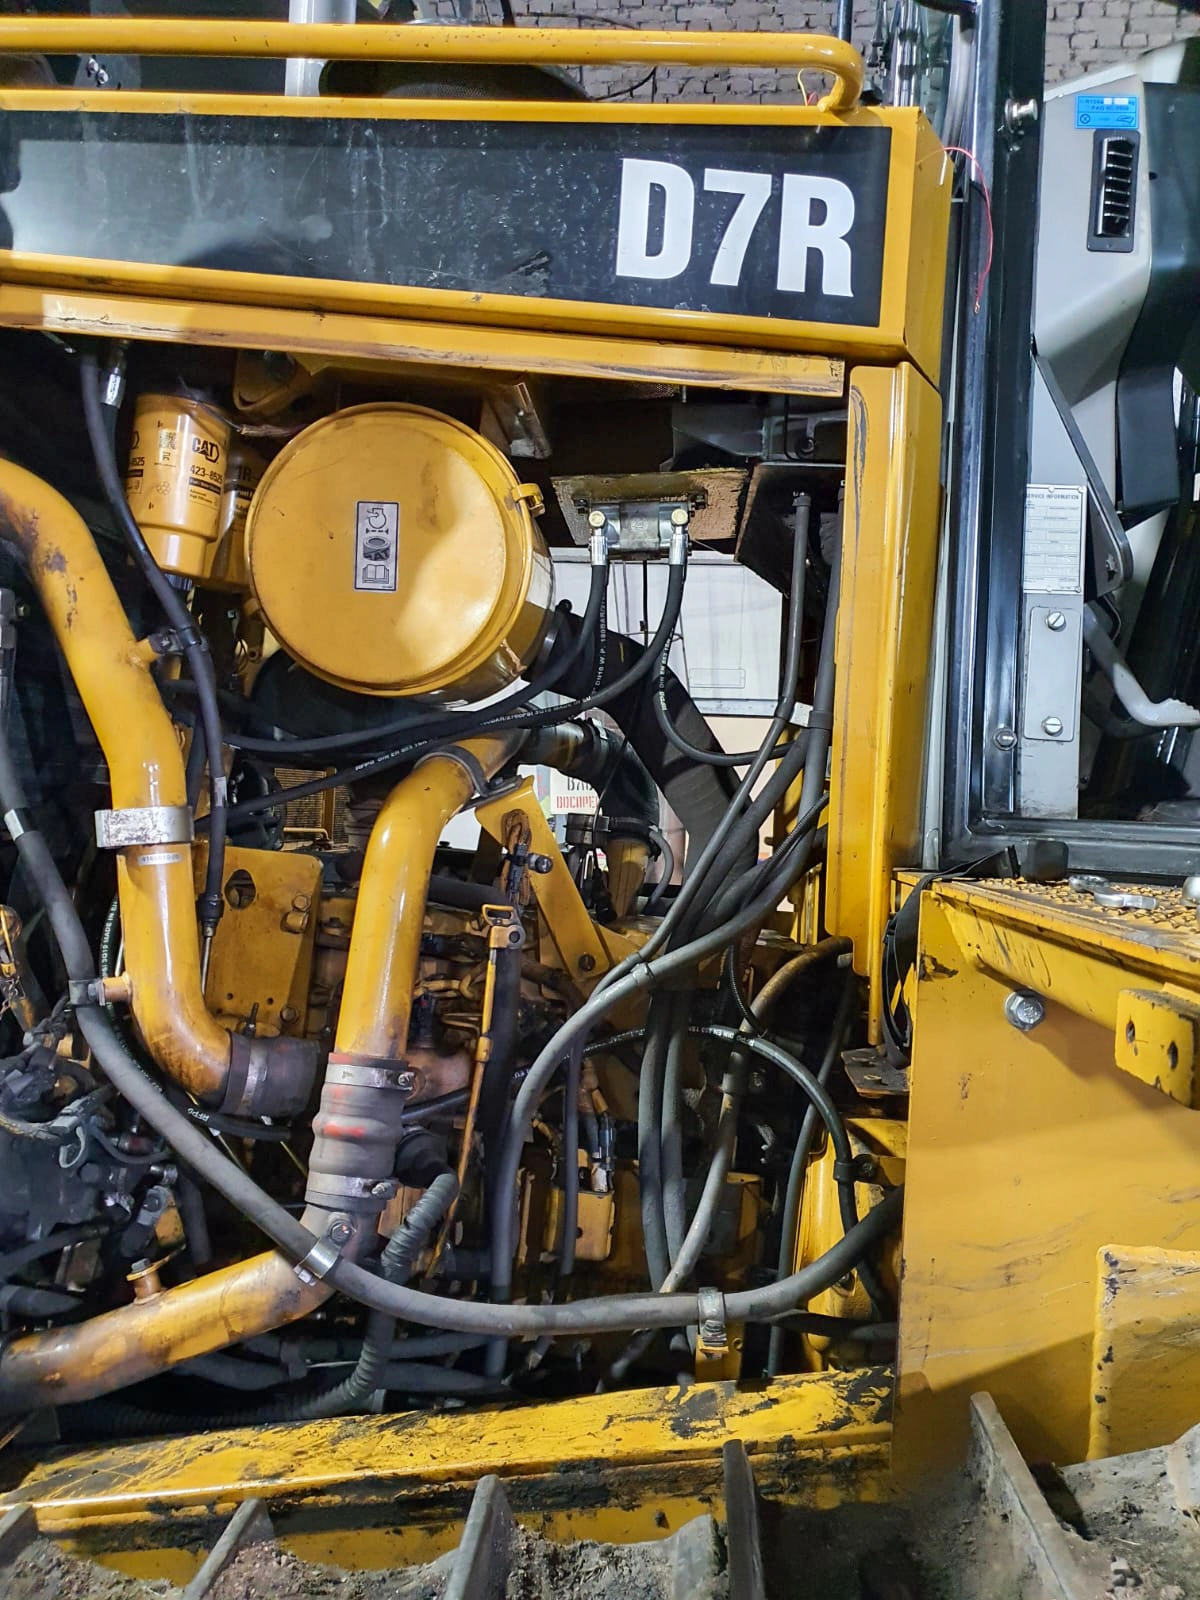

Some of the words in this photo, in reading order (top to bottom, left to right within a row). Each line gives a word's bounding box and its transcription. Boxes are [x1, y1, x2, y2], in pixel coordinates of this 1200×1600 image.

[616, 158, 856, 297] D7R
[192, 437, 219, 460] CAT
[103, 922, 112, 943] MADE
